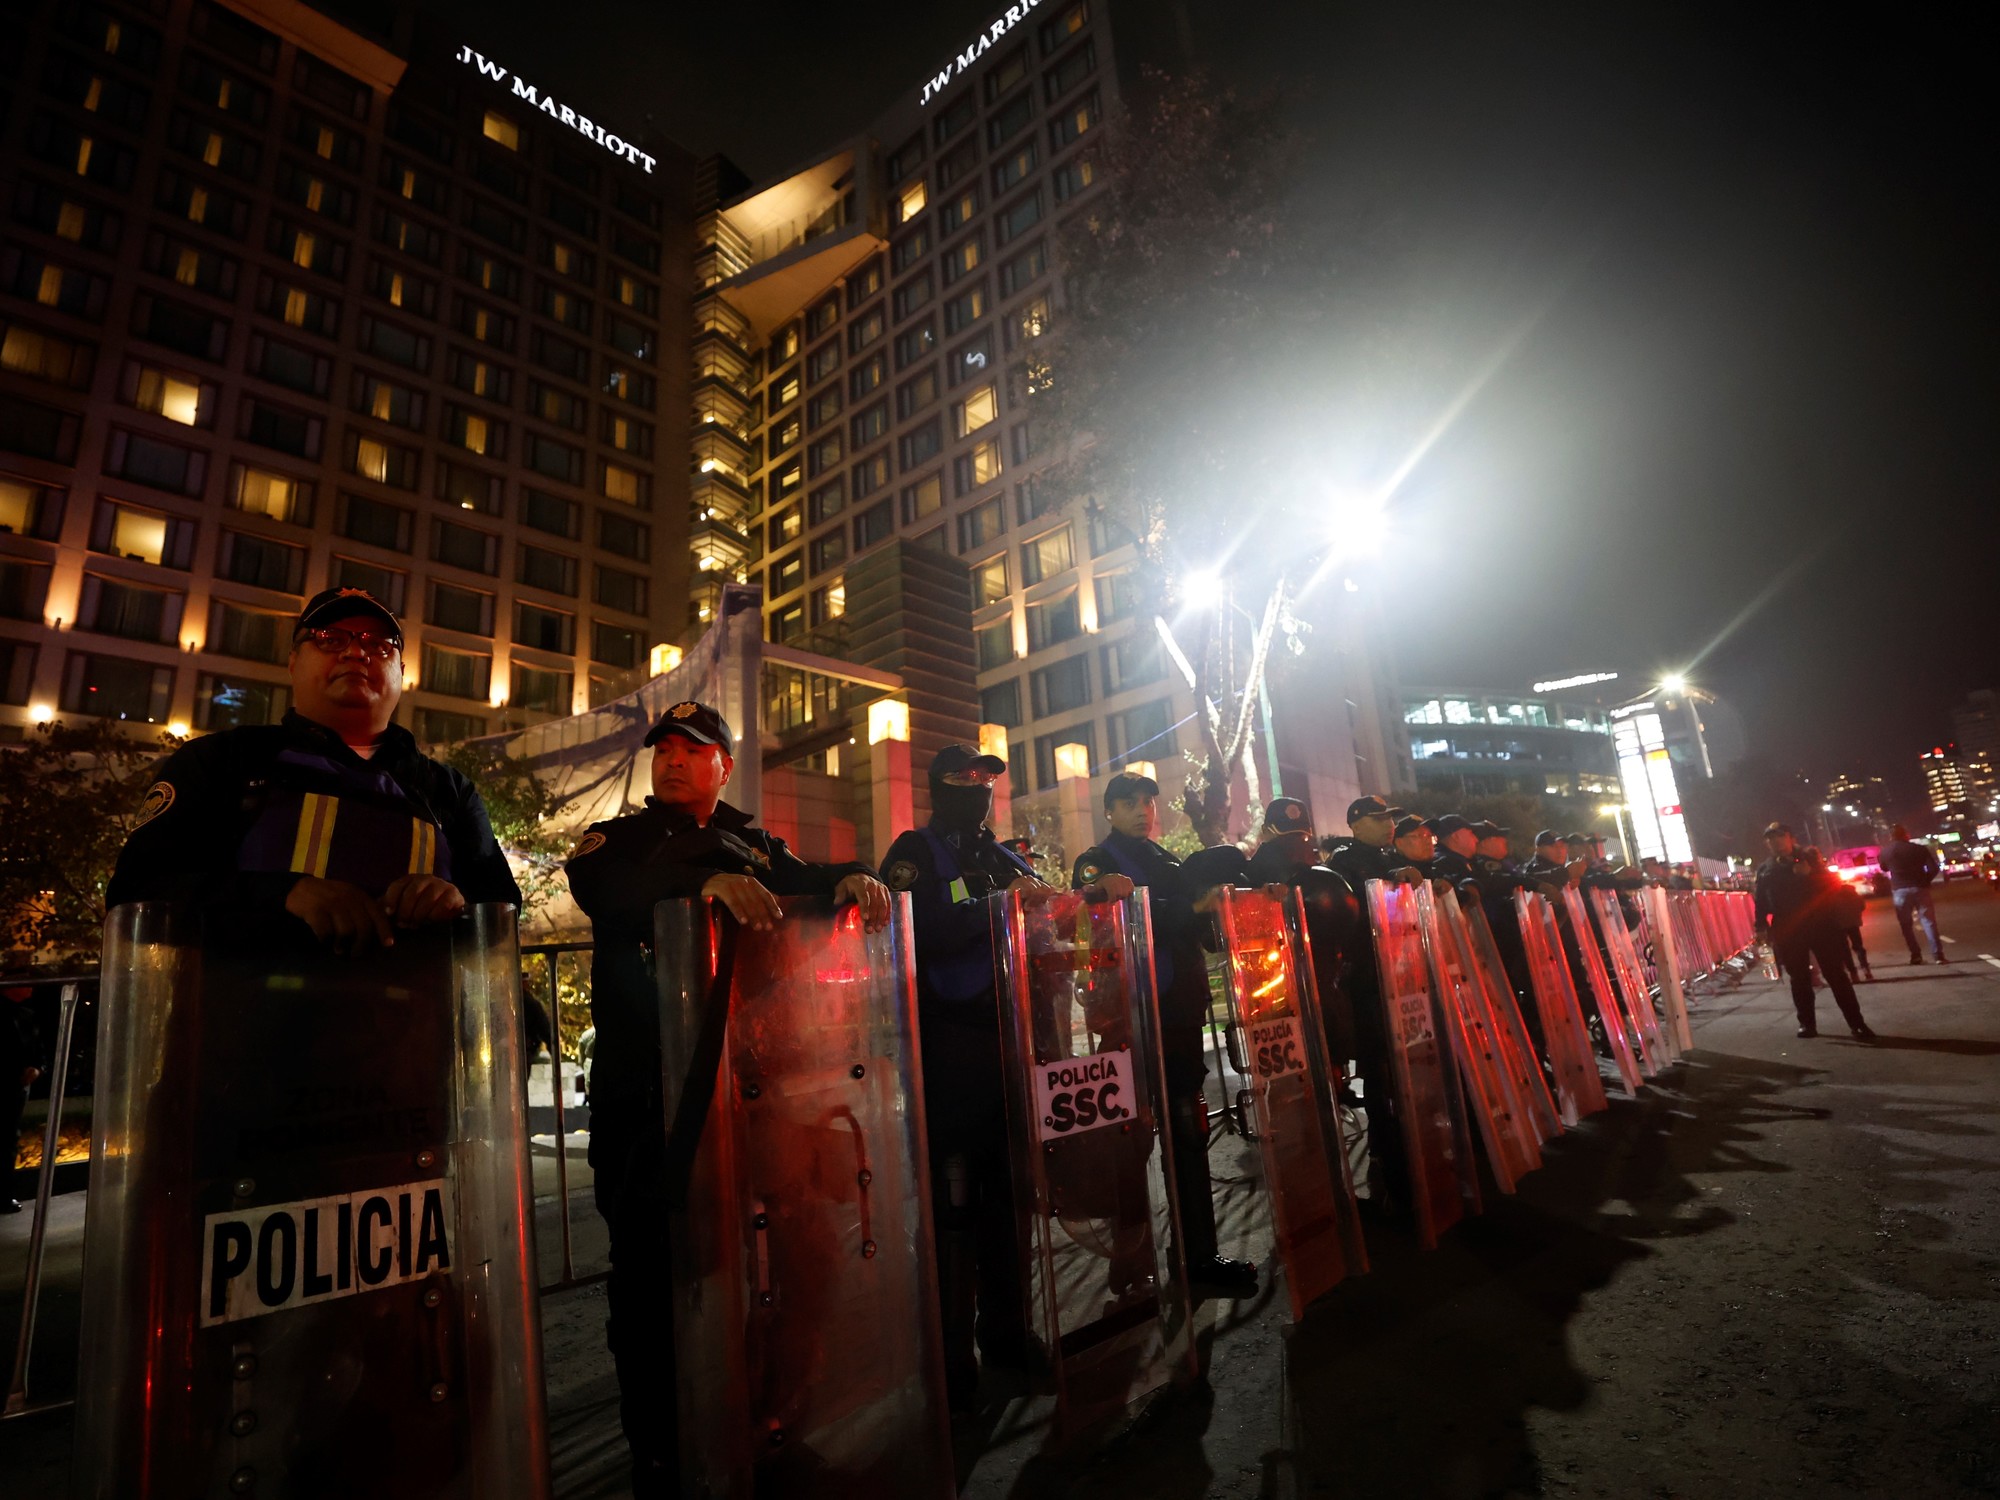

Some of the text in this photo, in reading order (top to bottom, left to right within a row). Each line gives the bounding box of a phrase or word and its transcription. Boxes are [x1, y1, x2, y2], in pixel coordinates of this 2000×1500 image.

[920, 63, 953, 106] JW
[456, 45, 657, 174] JW MARRIOTT
[1253, 1020, 1293, 1045] POLICÍA
[1047, 1057, 1119, 1091] POLICÍA
[1258, 1040, 1299, 1077] SSC
[1051, 1082, 1122, 1132] SSC
[209, 1188, 451, 1319] POLICIA
